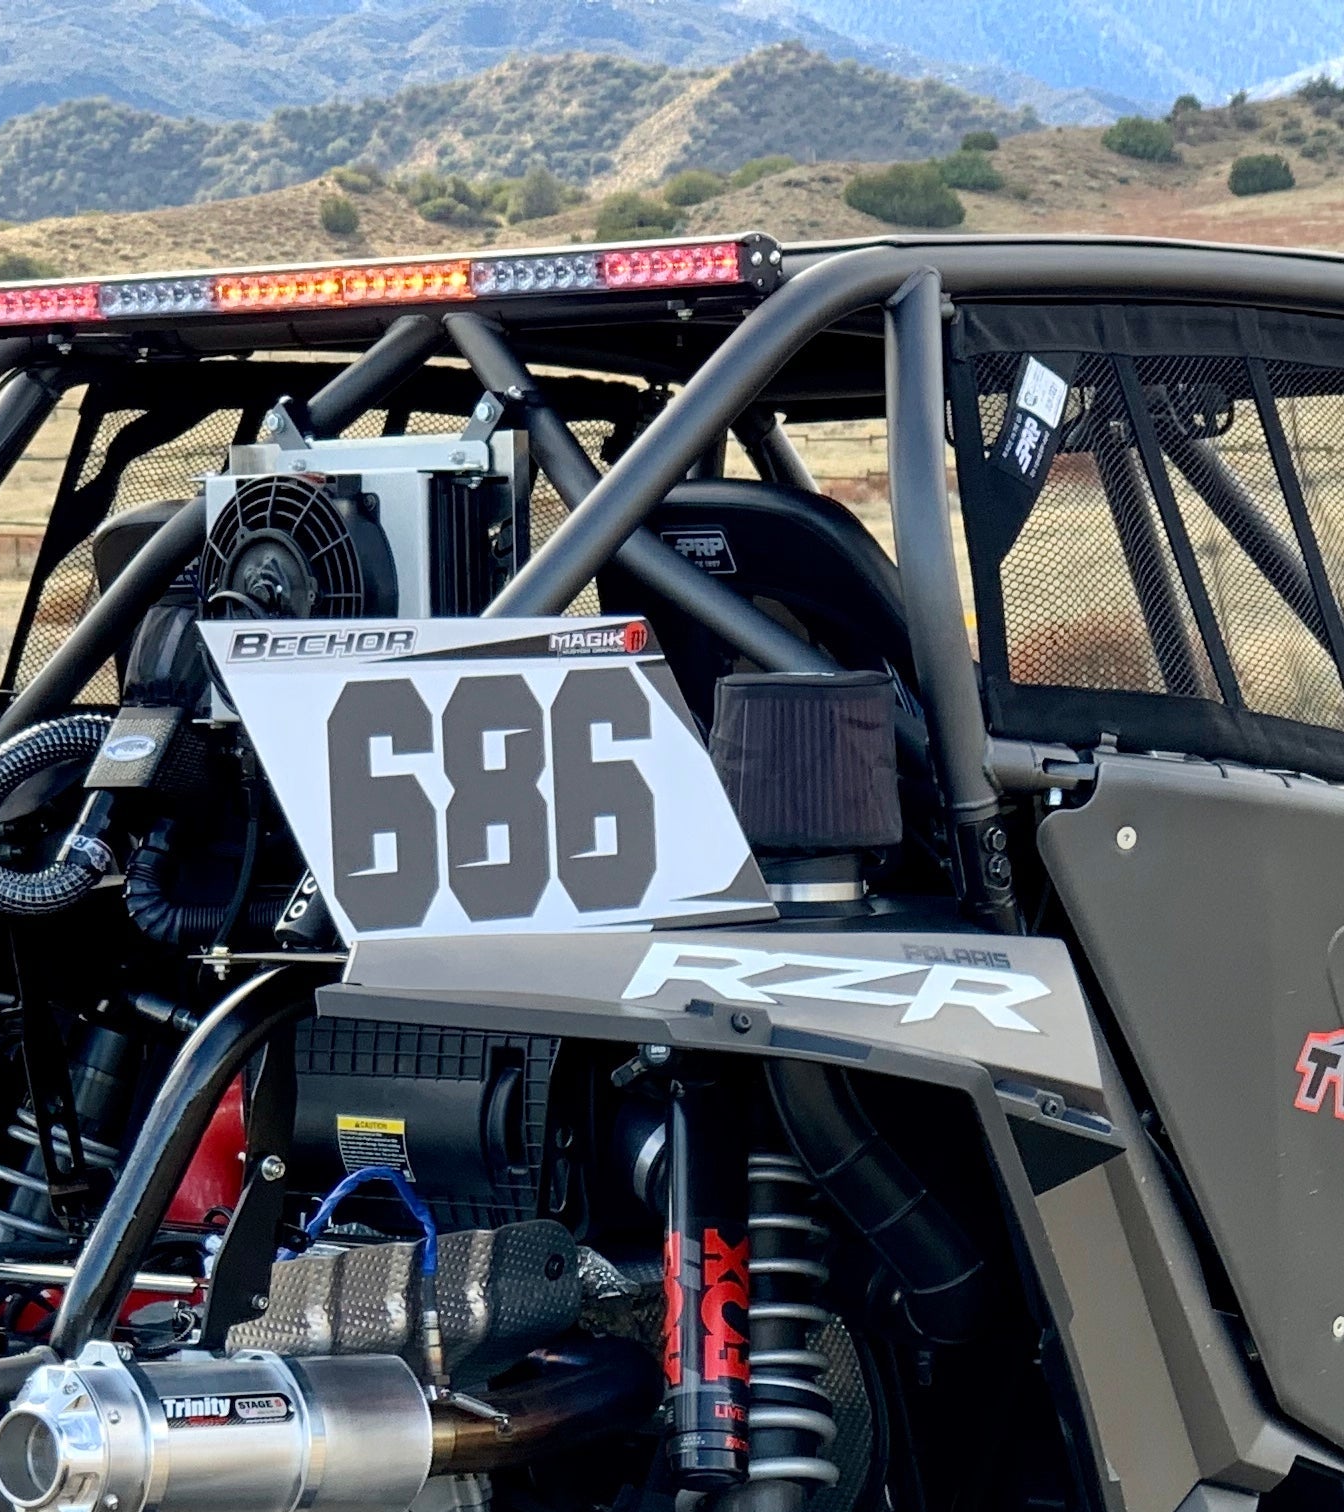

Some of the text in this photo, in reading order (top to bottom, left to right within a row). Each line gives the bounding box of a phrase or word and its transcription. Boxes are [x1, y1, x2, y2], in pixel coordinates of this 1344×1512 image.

[227, 629, 417, 663] BECHOR
[549, 632, 625, 652] MAGIK
[327, 666, 657, 933] 686
[900, 943, 1011, 969] POLARIS
[621, 942, 1051, 1034] RZR
[360, 1120, 388, 1130] CAUTION
[701, 1228, 750, 1385] FOX
[163, 1397, 231, 1418] Trinity
[237, 1399, 273, 1410] STAGE
